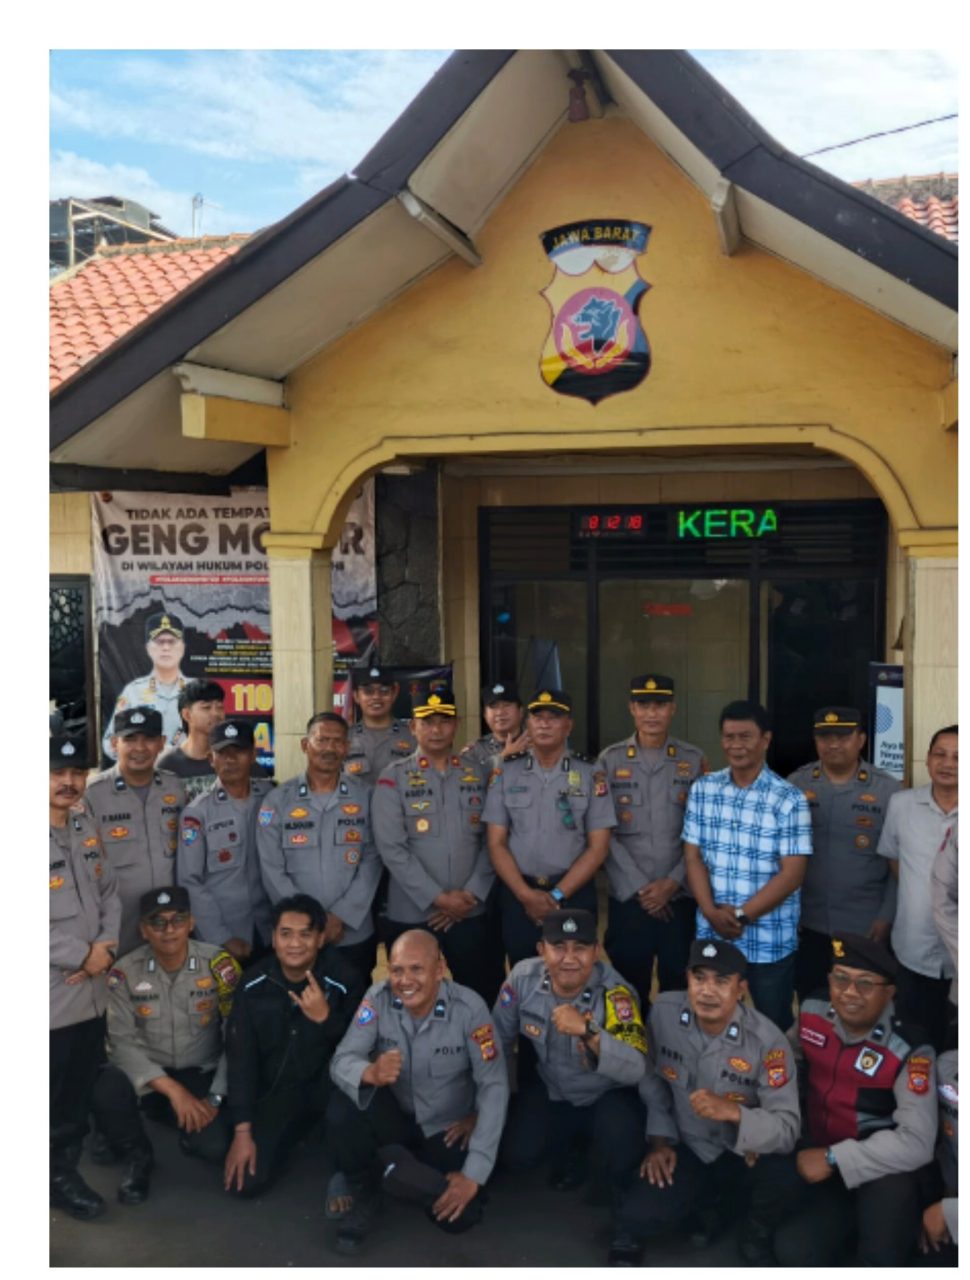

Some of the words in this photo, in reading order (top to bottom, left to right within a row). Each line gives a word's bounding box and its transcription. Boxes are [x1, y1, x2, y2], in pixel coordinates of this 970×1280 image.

[553, 228, 591, 247] JAWA
[594, 227, 640, 241] BARAT
[126, 509, 171, 520] TIDAK
[176, 508, 208, 519] ADA
[678, 509, 777, 538] KERA
[102, 523, 209, 555] GENG
[122, 562, 133, 571] DI
[138, 561, 193, 571] WILAYAH
[197, 561, 242, 571] HUKUM
[231, 684, 272, 711] 110
